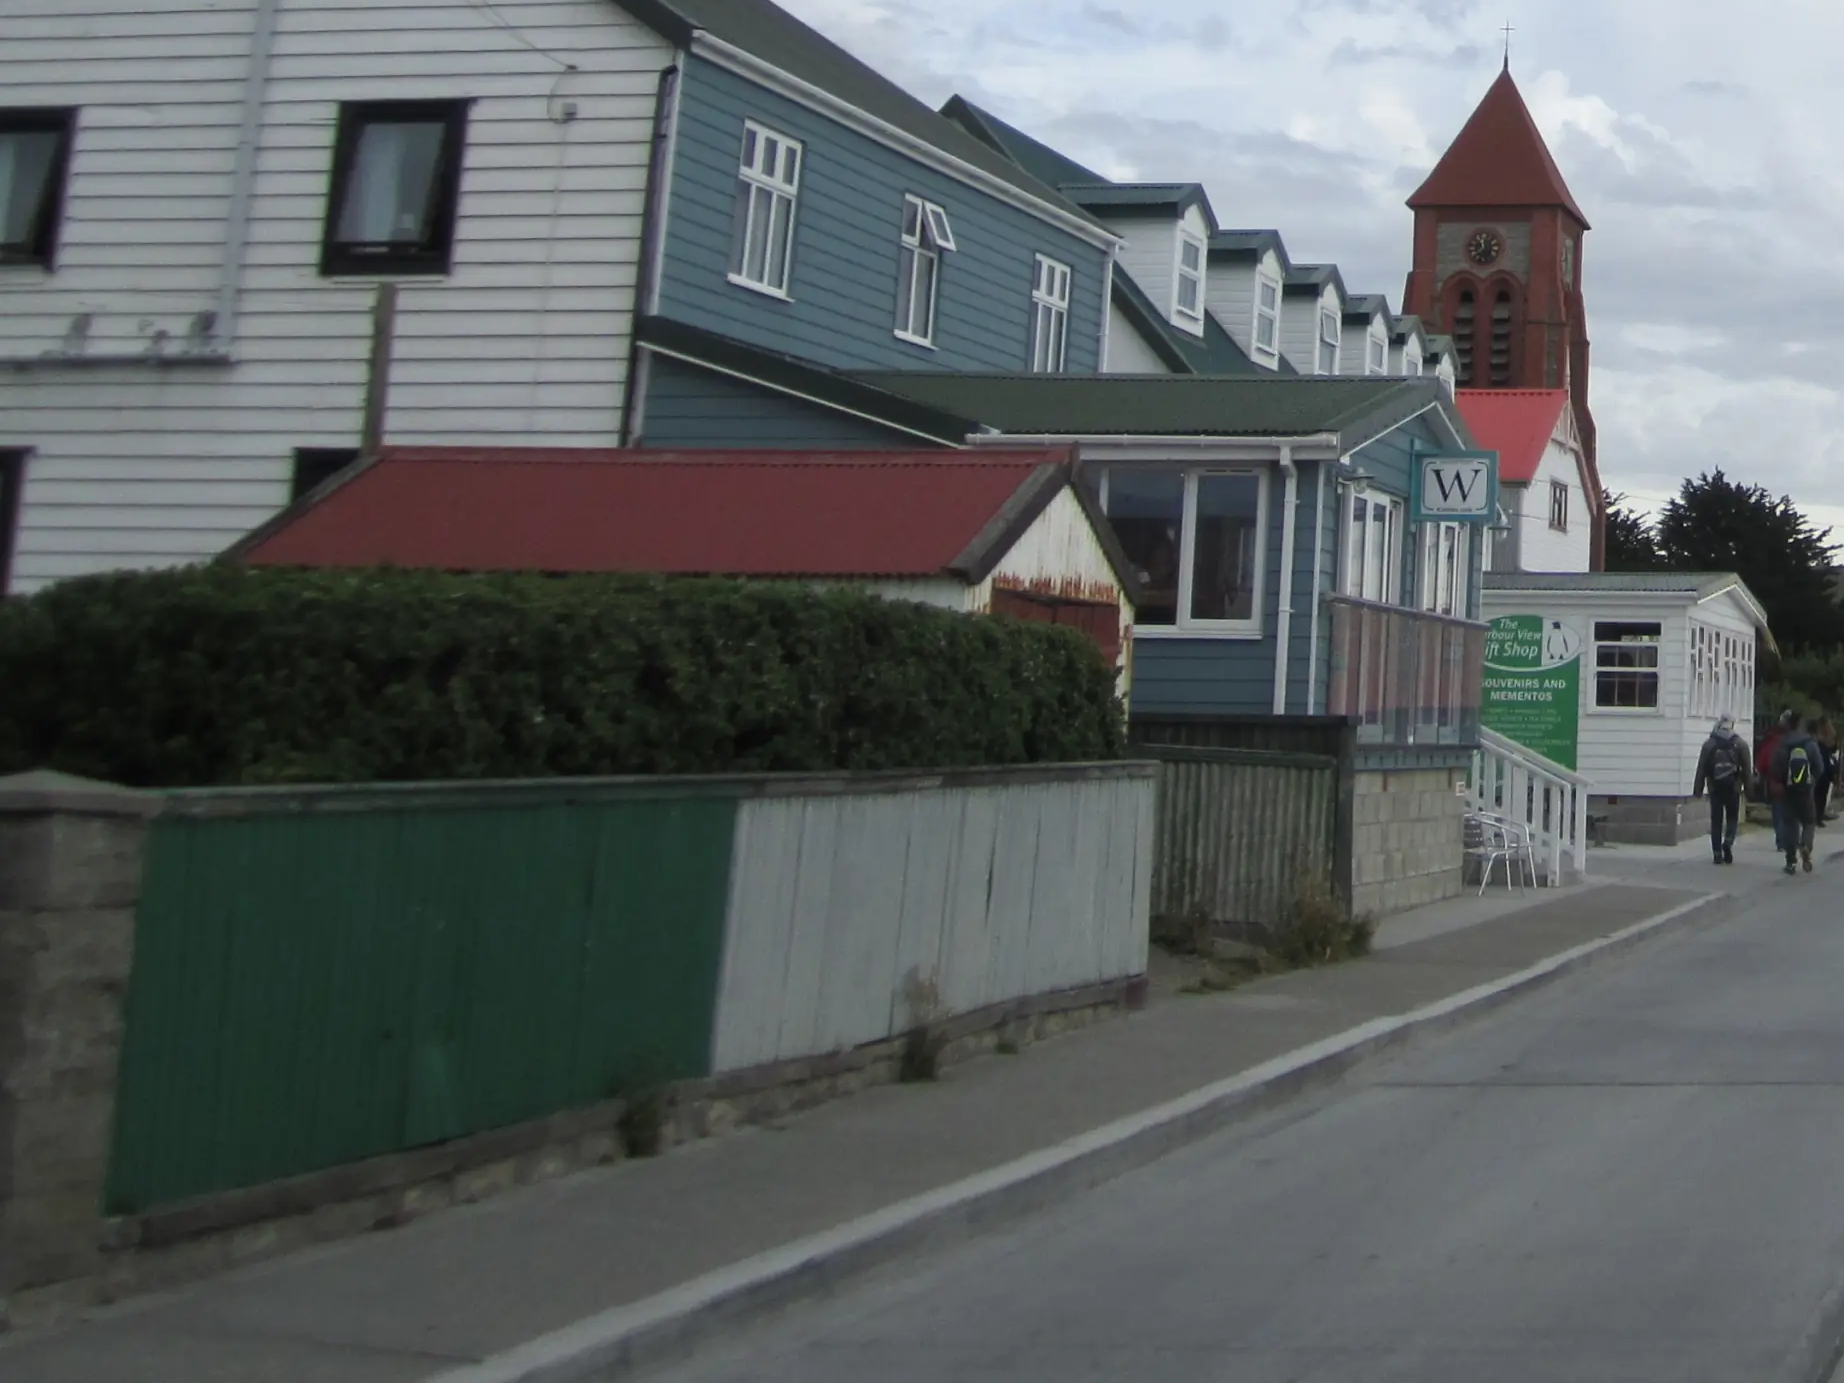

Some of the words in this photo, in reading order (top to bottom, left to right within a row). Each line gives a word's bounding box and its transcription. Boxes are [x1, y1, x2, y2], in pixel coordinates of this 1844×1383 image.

[1431, 468, 1483, 503] W
[1500, 618, 1518, 629] The
[1485, 629, 1515, 640] rbour
[1517, 628, 1542, 641] View
[1485, 640, 1499, 660] ift
[1502, 641, 1538, 660] Shop
[1543, 678, 1566, 689] AND
[1490, 691, 1553, 702] MEMENTOS
